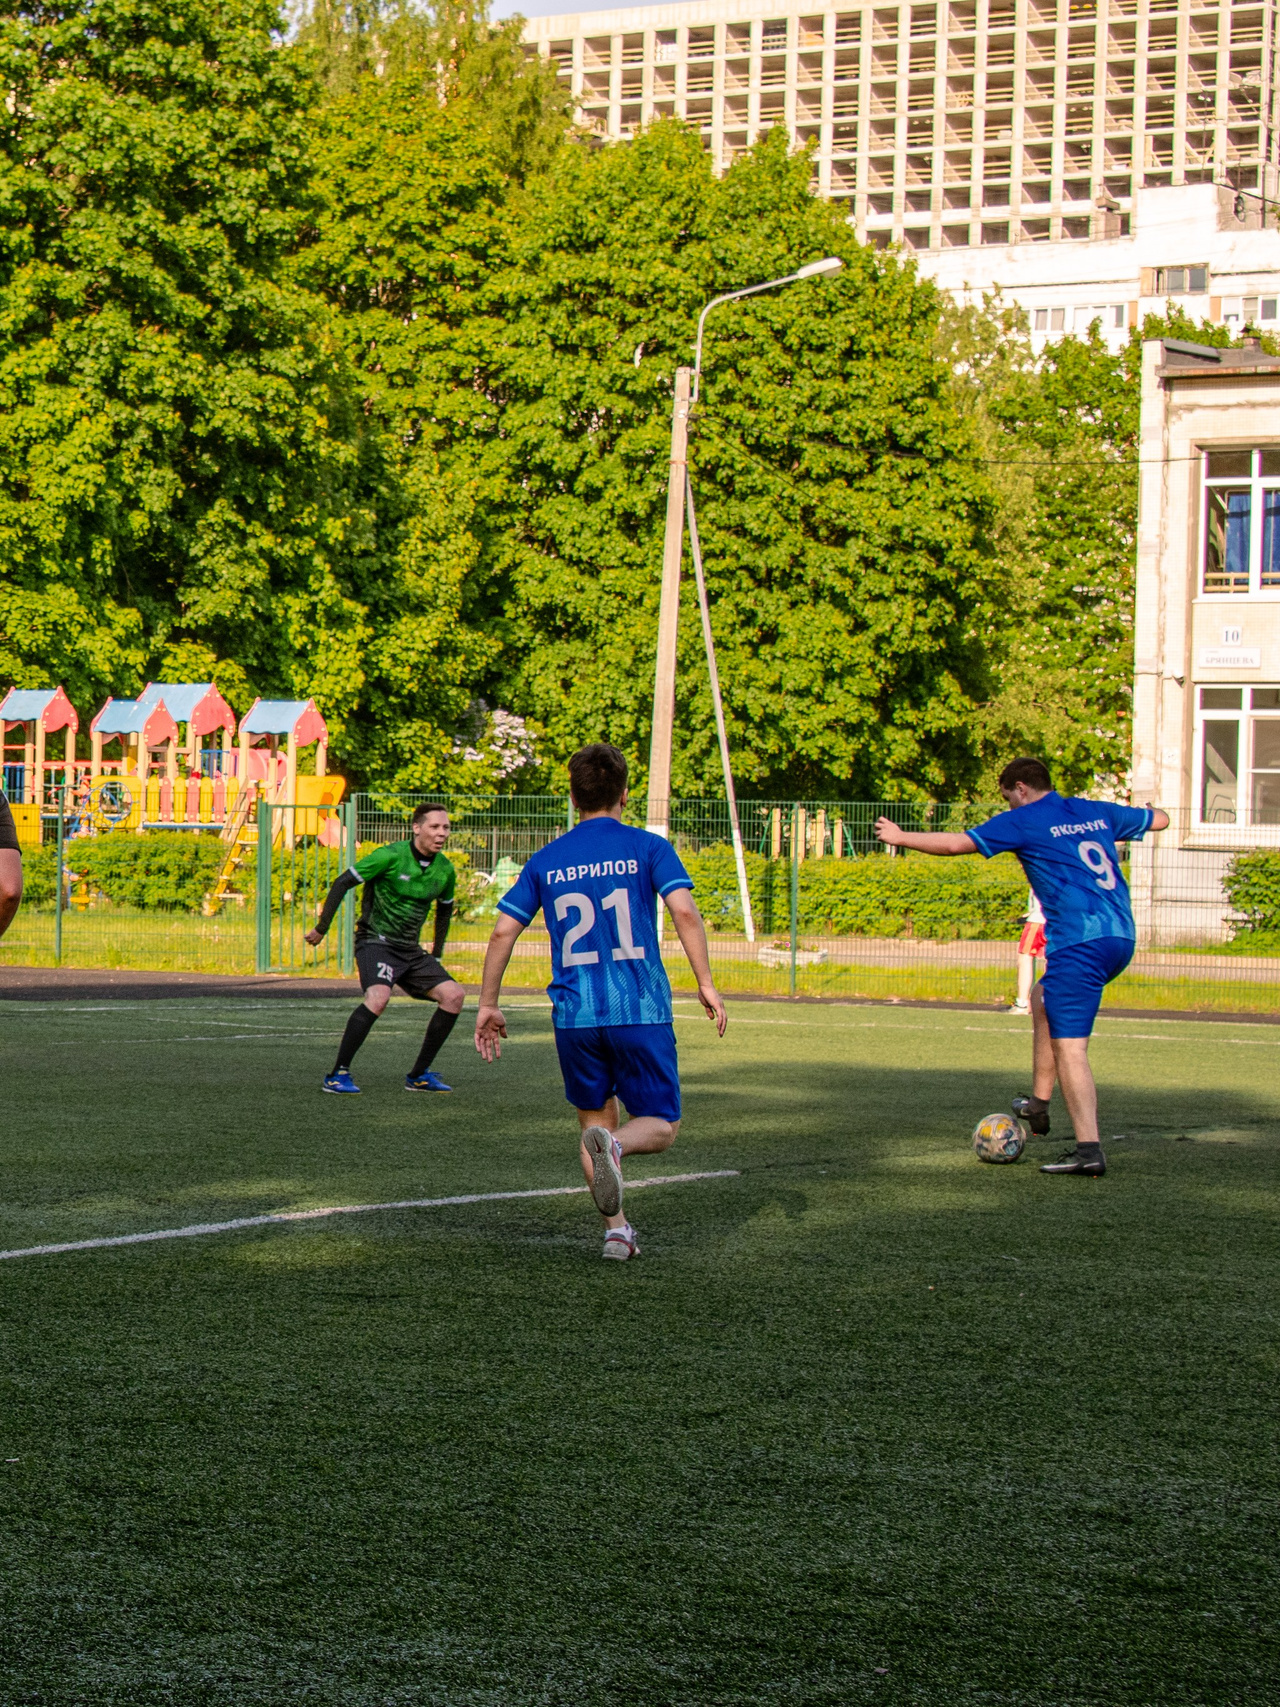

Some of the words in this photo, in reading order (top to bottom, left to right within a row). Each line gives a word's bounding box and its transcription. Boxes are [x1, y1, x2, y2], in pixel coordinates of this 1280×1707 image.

[1225, 630, 1240, 643] 10
[546, 859, 639, 885] ГАВРИЛОВ
[1078, 840, 1116, 890] 9
[554, 887, 645, 968] 21
